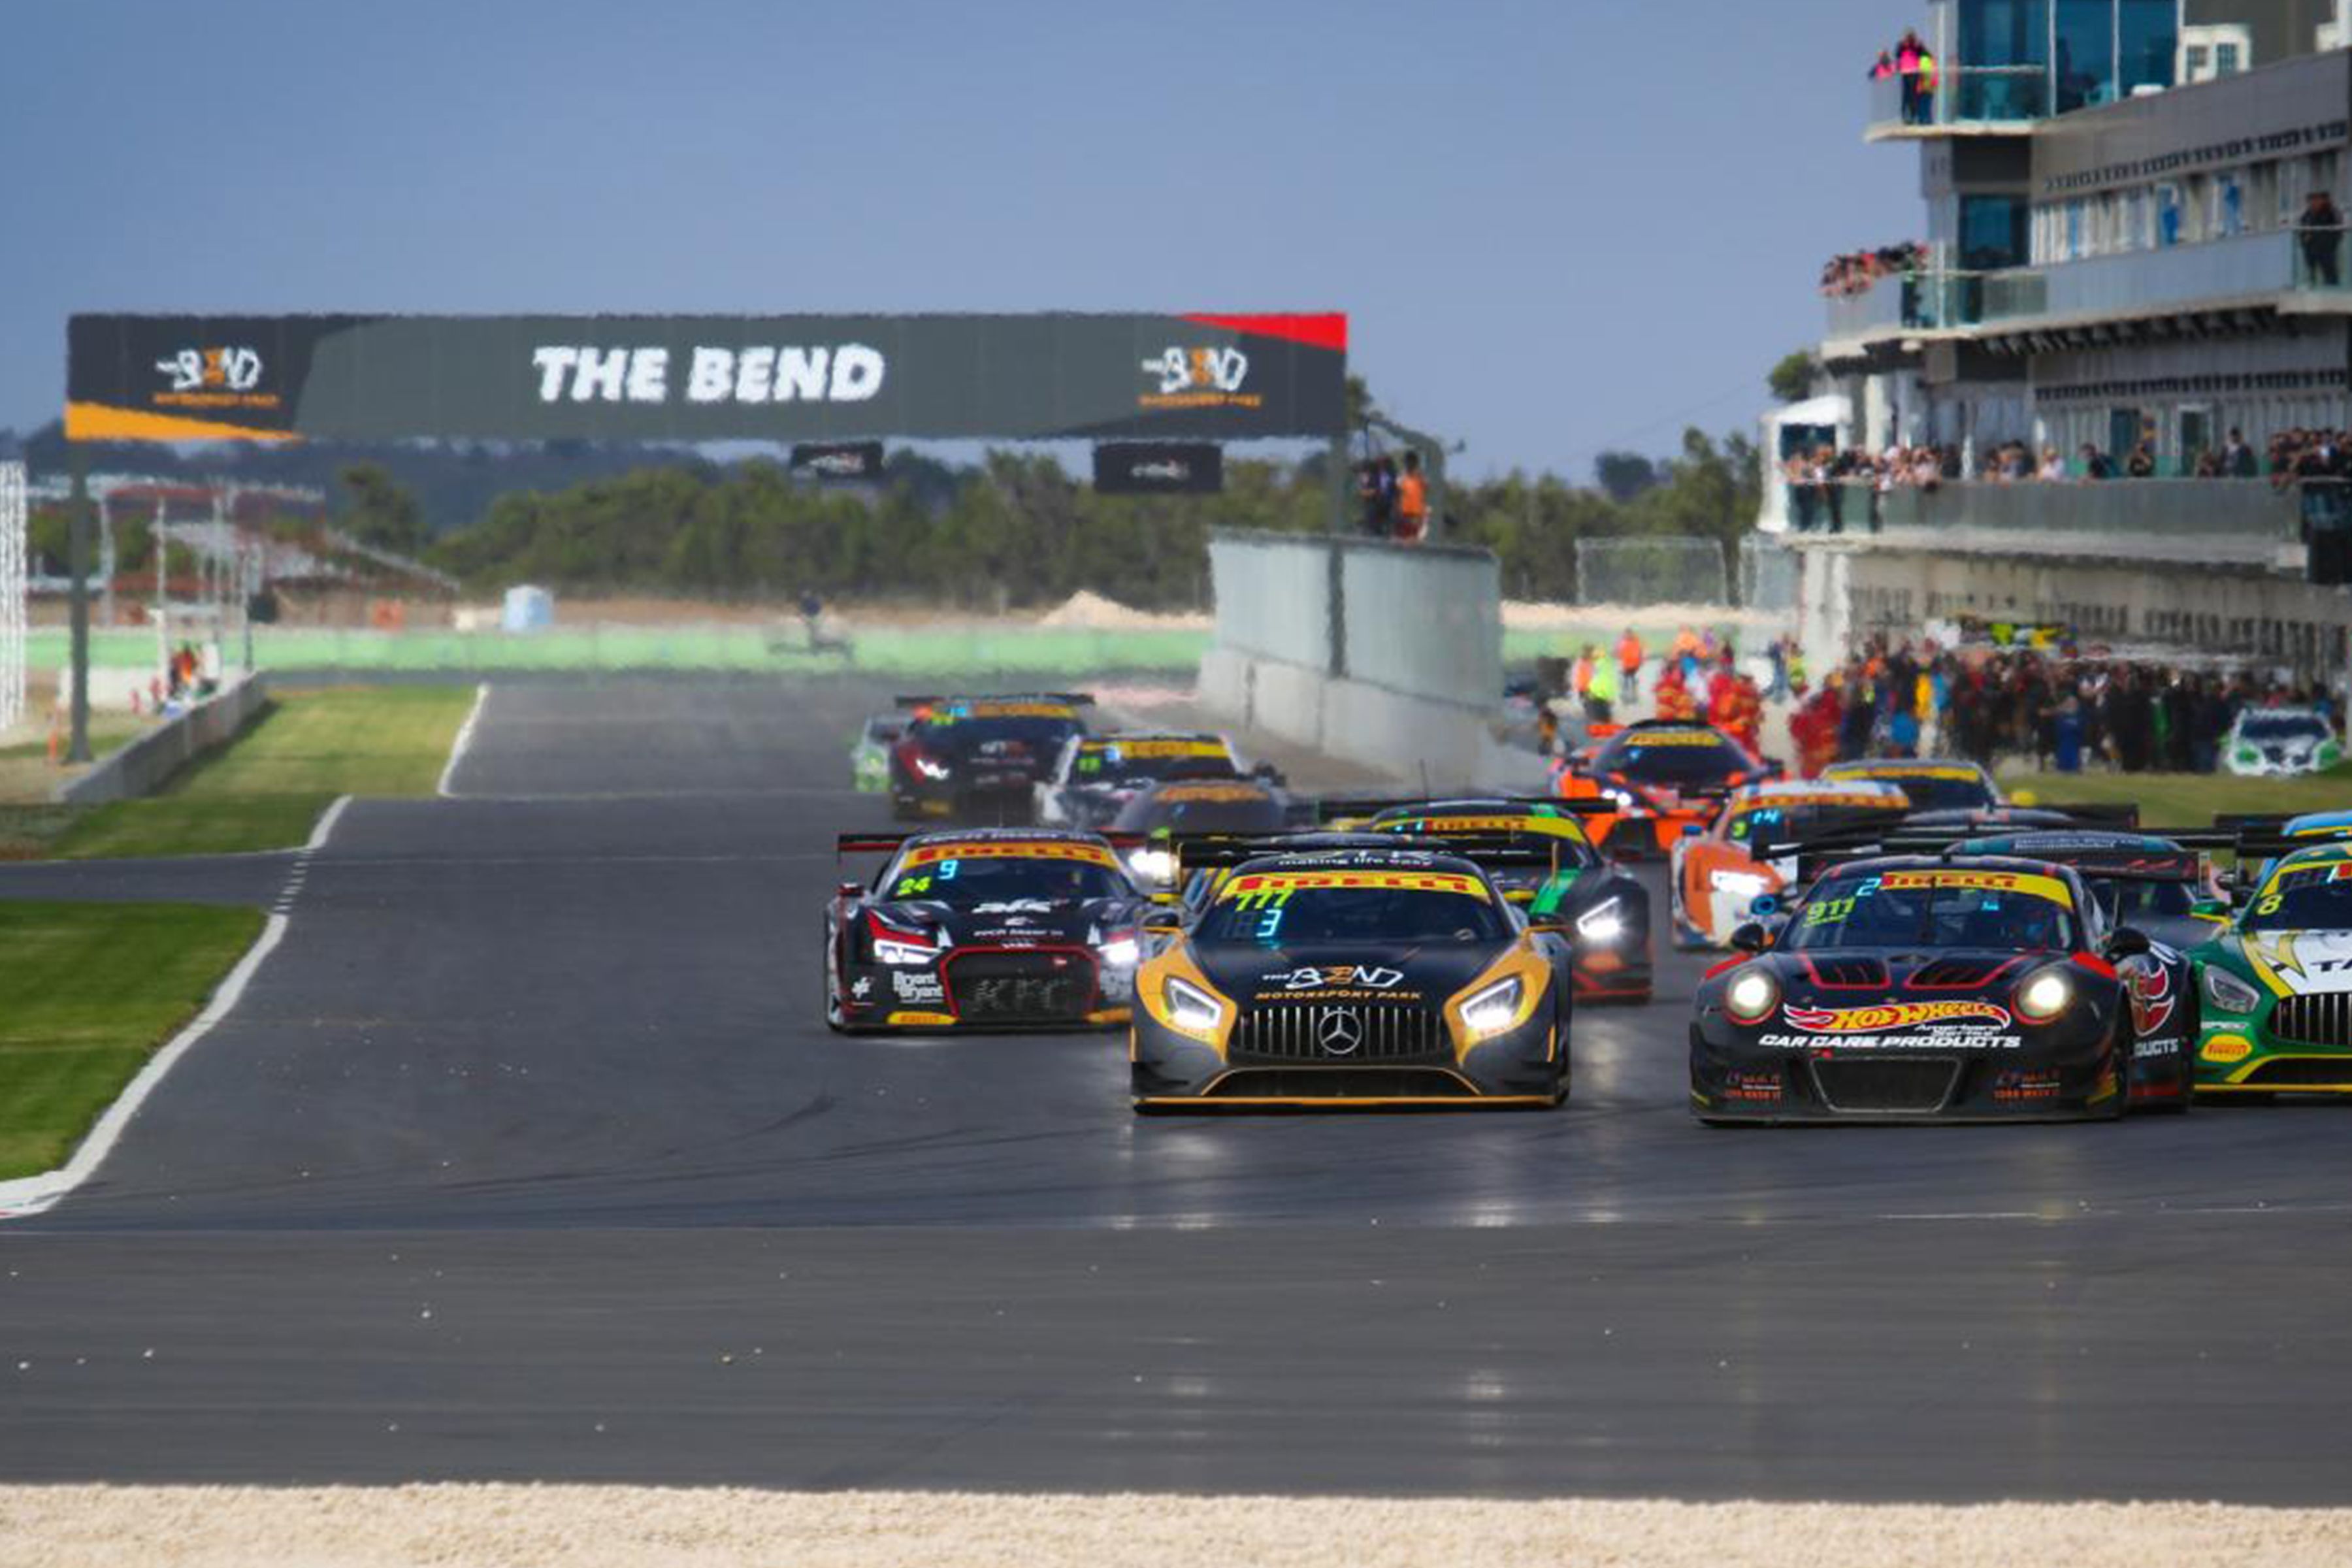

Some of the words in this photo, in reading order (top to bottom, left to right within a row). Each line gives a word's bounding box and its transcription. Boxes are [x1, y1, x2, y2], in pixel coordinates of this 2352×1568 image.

[532, 346, 669, 402] THE
[687, 342, 885, 402] BEND
[938, 859, 958, 879] 9
[897, 876, 932, 895] 24
[1856, 878, 1882, 897] 2
[1235, 889, 1295, 912] 777
[1806, 896, 1857, 921] 911
[2257, 893, 2284, 915] 8
[1256, 909, 1283, 937] 3
[1254, 990, 1373, 1000] MOTORSPORT
[1377, 991, 1422, 1000] PARK
[1759, 1034, 1808, 1047] CAR
[1810, 1035, 1880, 1047] CARE
[1881, 1034, 2022, 1048] PRODUCTS
